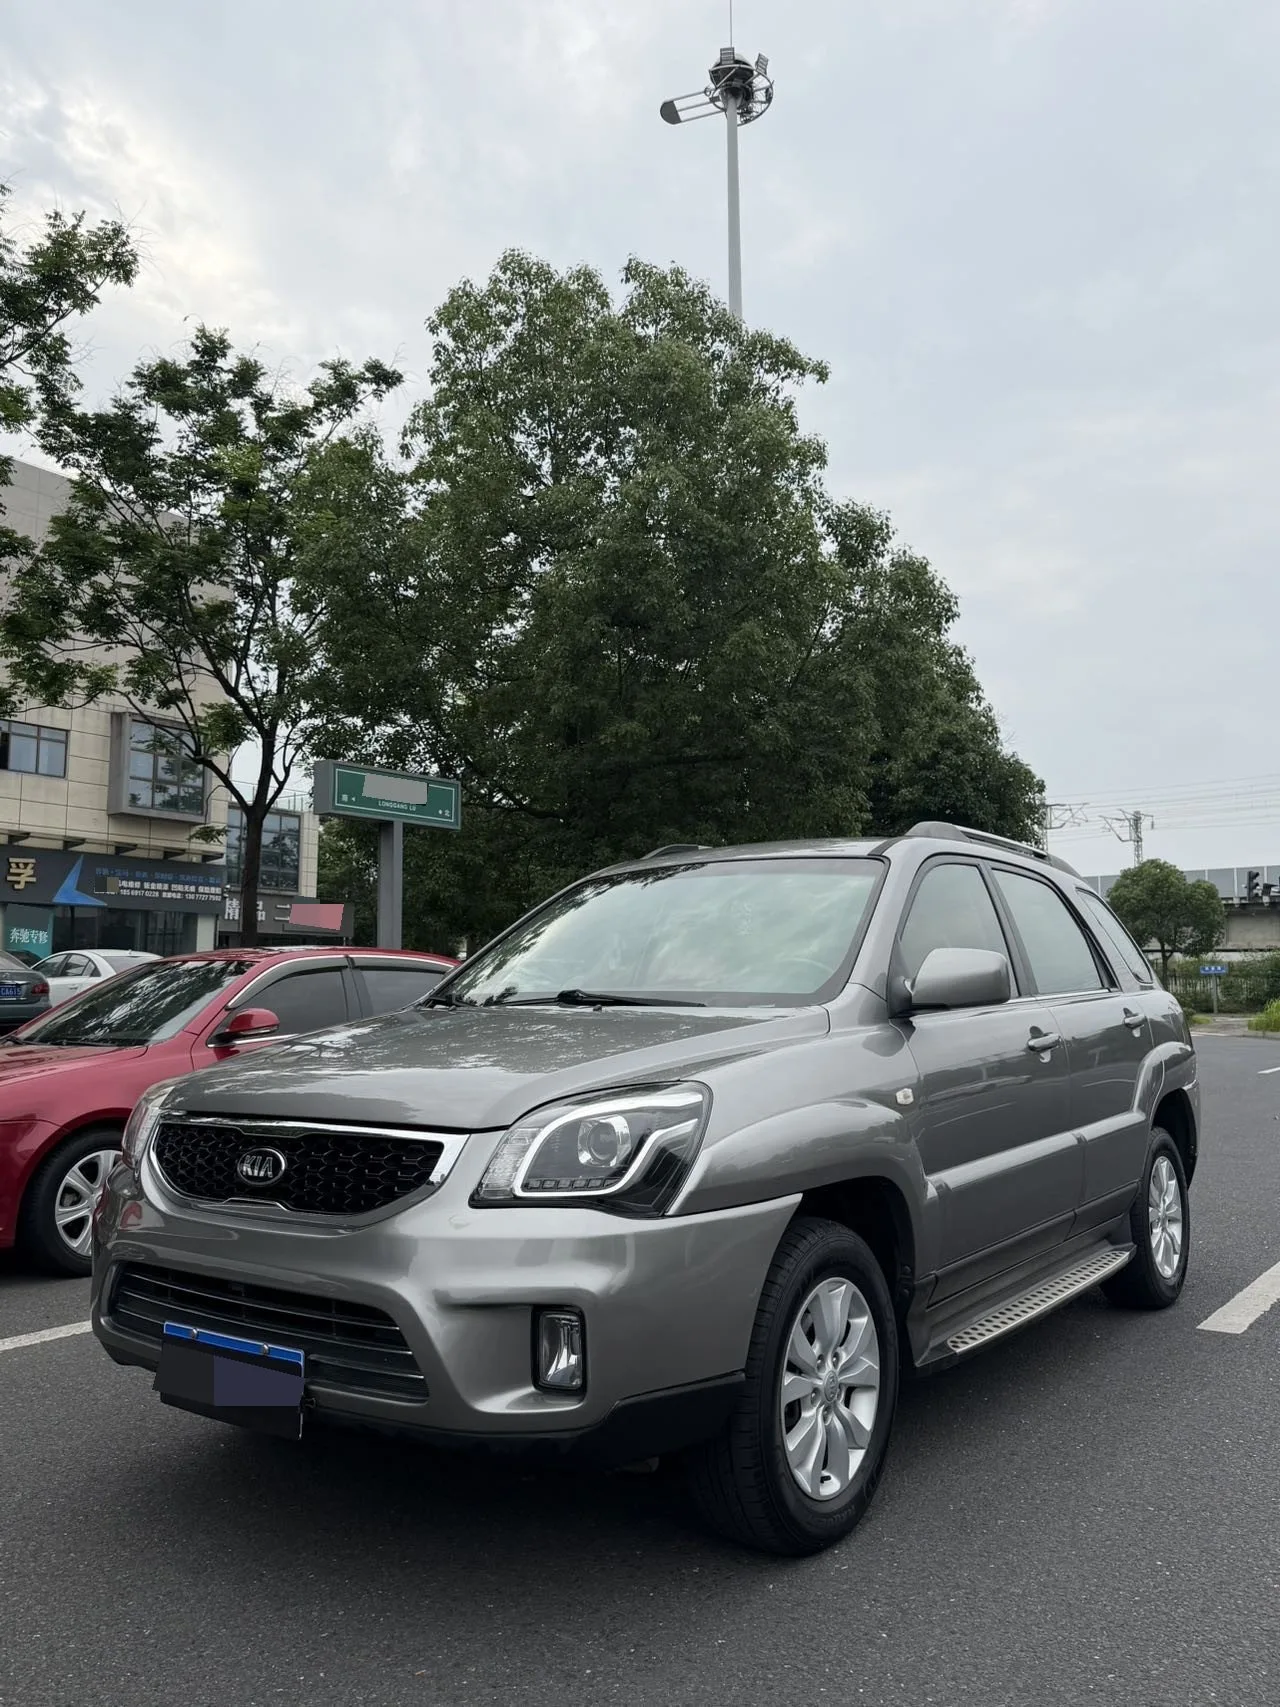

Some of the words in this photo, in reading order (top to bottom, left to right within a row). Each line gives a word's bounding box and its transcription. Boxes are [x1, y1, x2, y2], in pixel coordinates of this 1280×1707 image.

[379, 801, 408, 811] LONGGANG
[7, 857, 37, 889] 孚
[9, 927, 48, 944] 奔驰专修
[242, 1154, 273, 1178] KIA
